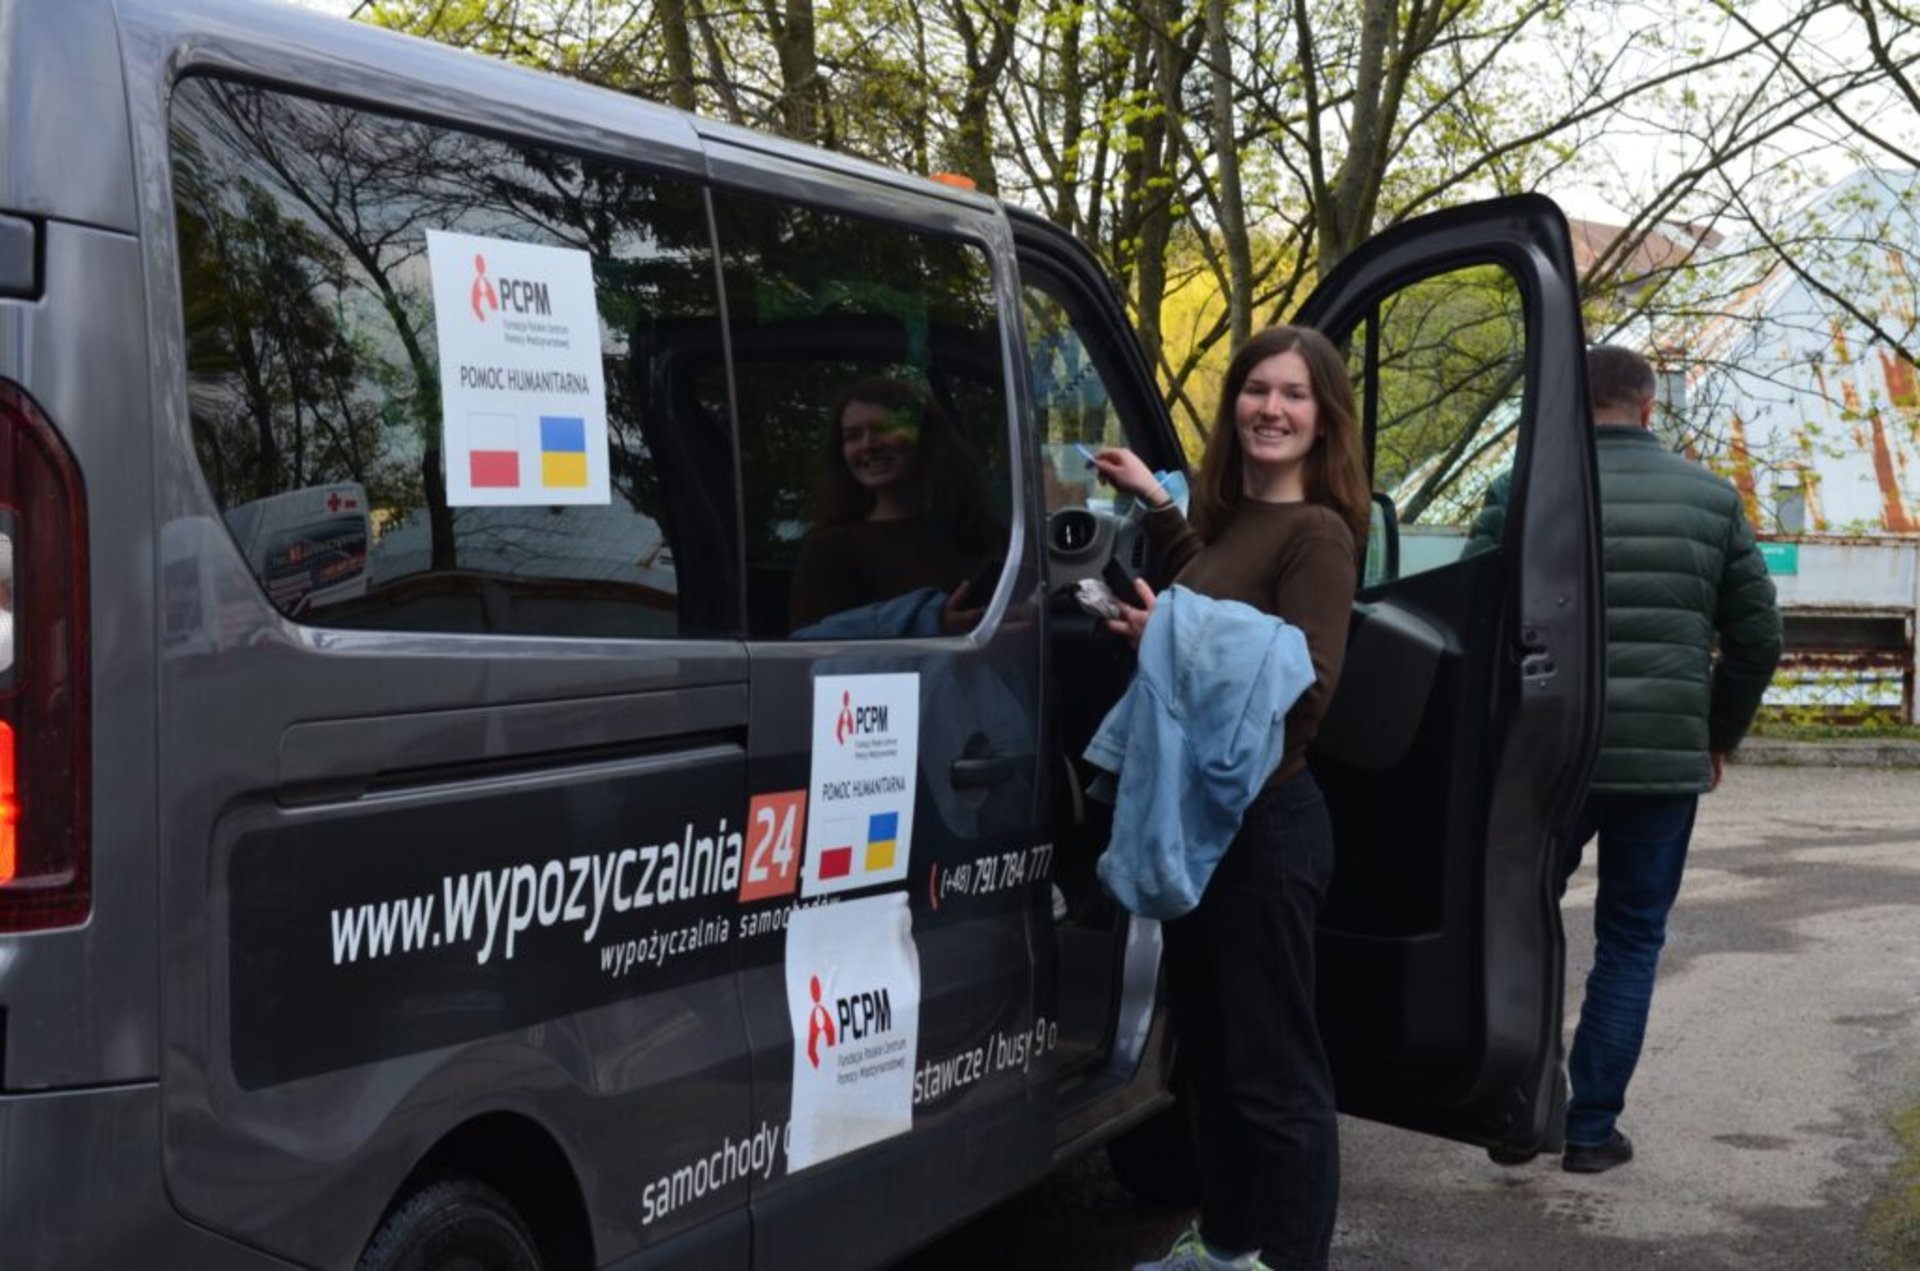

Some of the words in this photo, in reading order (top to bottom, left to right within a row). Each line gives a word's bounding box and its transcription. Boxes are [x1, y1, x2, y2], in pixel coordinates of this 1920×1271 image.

[499, 277, 552, 316] PCPM
[460, 365, 505, 390] POMOC
[507, 368, 590, 395] HUMANITARNA
[856, 704, 888, 735] PCPM
[822, 780, 851, 801] POMOC
[853, 775, 907, 799] HUMANITARNA
[972, 855, 999, 895] 791
[999, 849, 1027, 889] 784
[1027, 843, 1053, 882] 777
[601, 915, 730, 978] wypożyczalnia
[837, 987, 892, 1044] PCPM
[914, 1047, 983, 1104] stawcze
[996, 1031, 1033, 1074] busy
[642, 1120, 779, 1225] samochody
